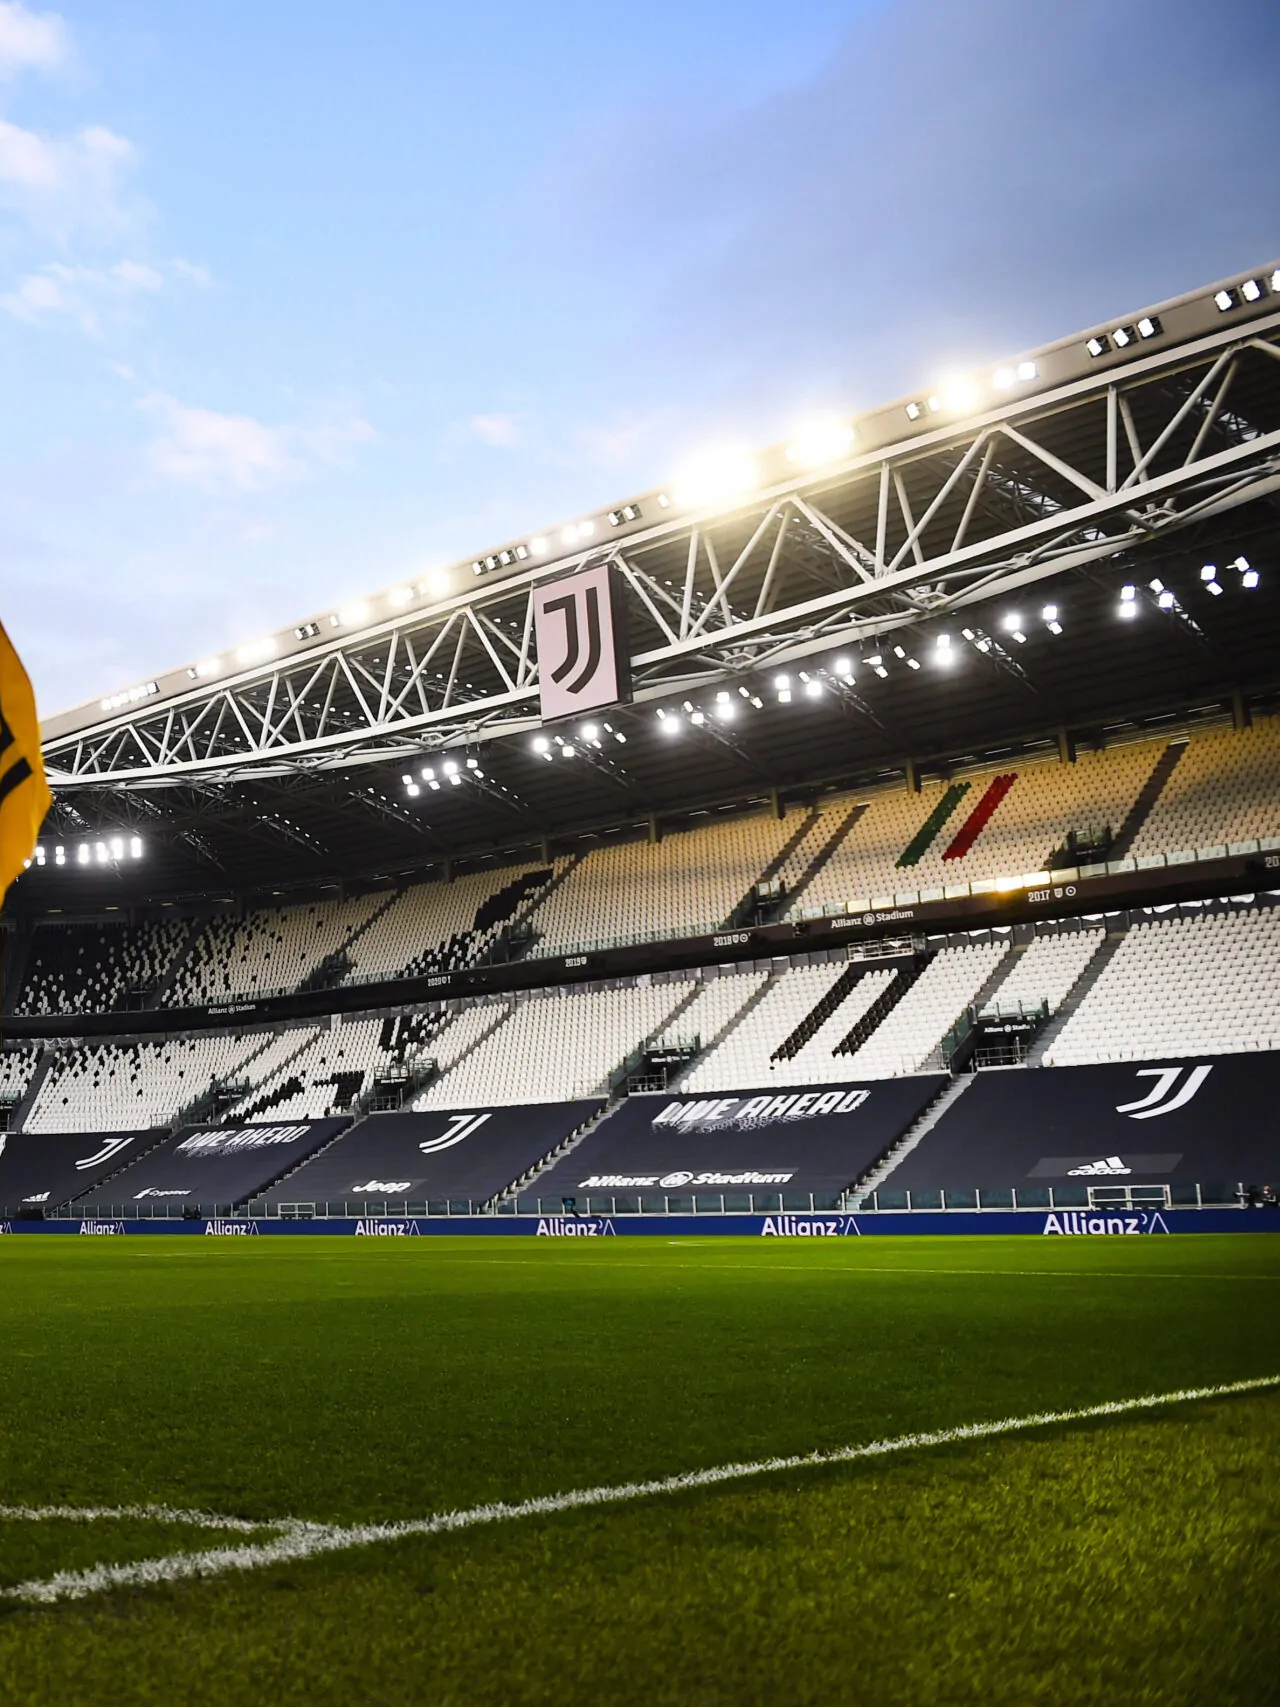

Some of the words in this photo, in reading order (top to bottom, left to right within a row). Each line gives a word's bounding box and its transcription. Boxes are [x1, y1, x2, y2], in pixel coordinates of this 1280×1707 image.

[1028, 890, 1050, 902] 2017
[831, 917, 862, 929] Allianz
[876, 910, 914, 922] Stadium
[236, 1004, 256, 1012] Stadium
[734, 1090, 871, 1120] AHEAD
[224, 1125, 312, 1147] AHEAD
[578, 1176, 660, 1187] Allianz
[692, 1172, 793, 1185] Stadium
[1067, 1167, 1132, 1176] adidas
[352, 1180, 411, 1194] Jeep
[80, 1221, 115, 1235] Allianz
[205, 1221, 248, 1235] Allianz
[355, 1219, 406, 1236] Allianz
[536, 1218, 598, 1236] Allianz
[761, 1216, 839, 1236] Allianz
[1043, 1213, 1140, 1235] Allianz
